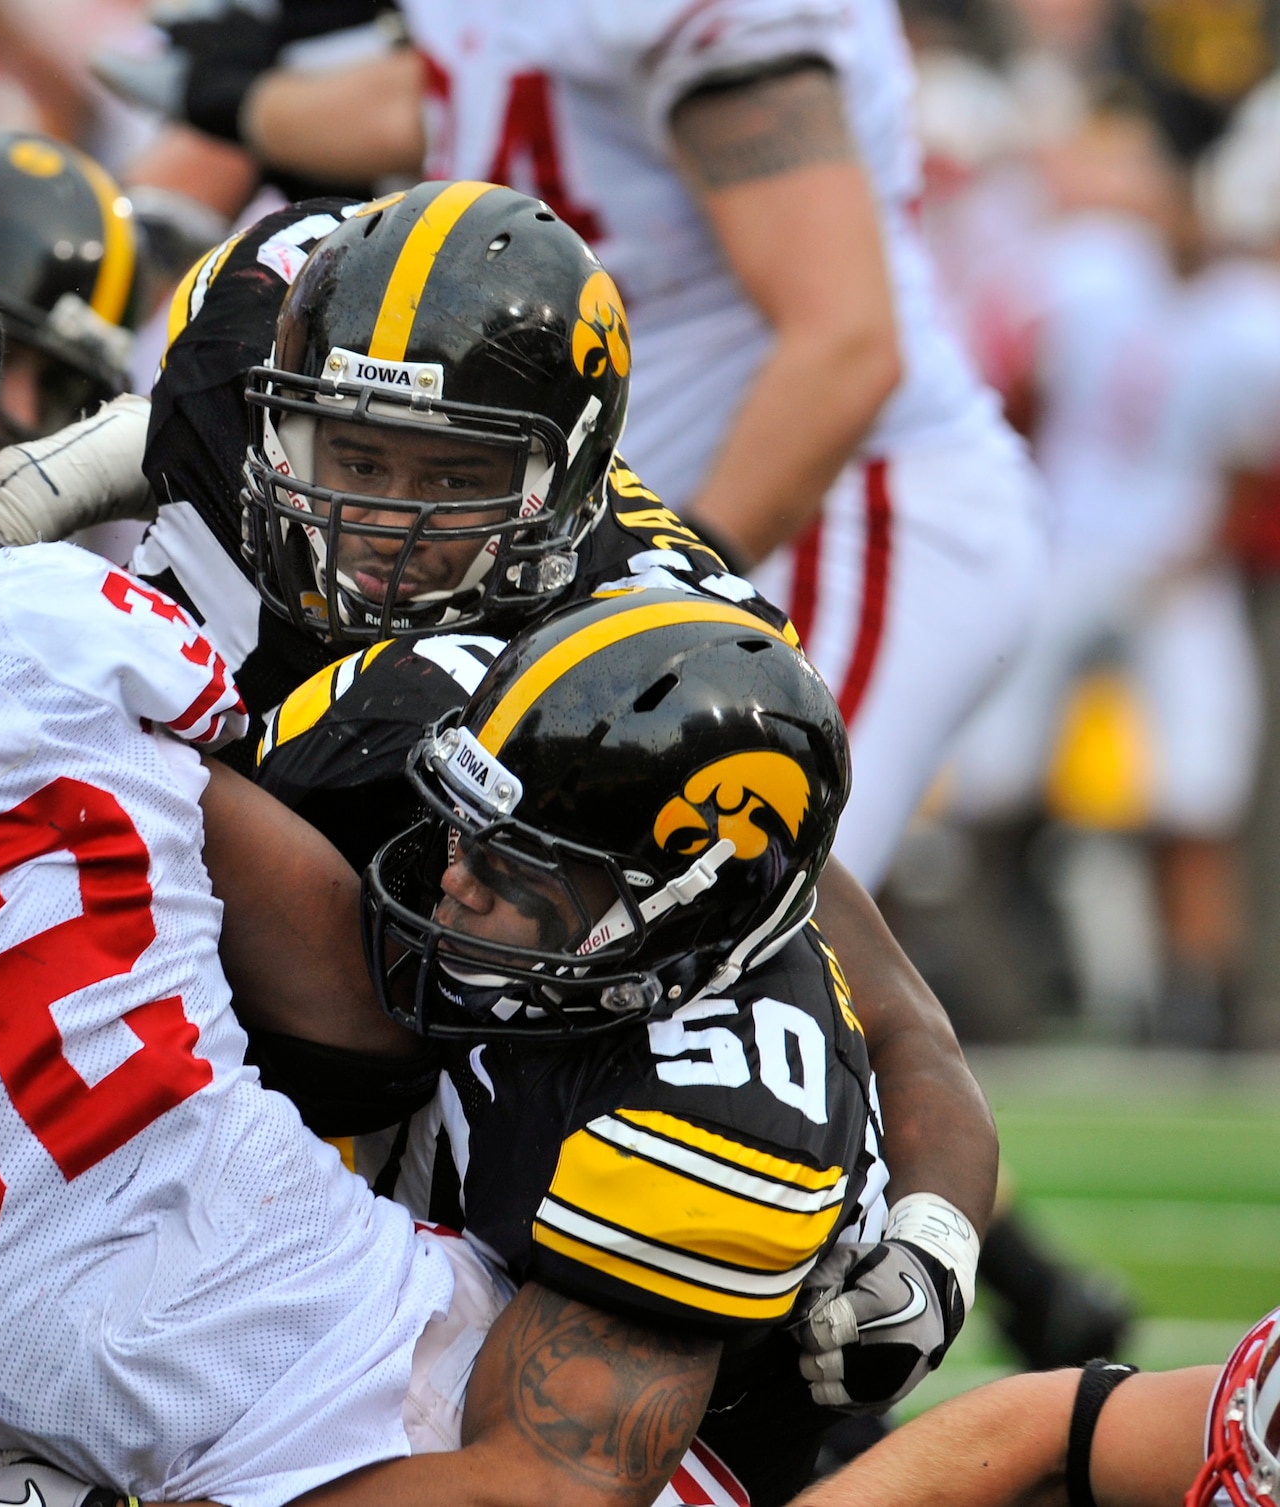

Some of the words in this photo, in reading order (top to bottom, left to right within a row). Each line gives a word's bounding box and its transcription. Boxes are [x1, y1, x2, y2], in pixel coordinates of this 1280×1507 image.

[356, 363, 412, 386] IOWA
[456, 743, 489, 787] IOWA
[623, 872, 654, 885] PEED
[646, 996, 829, 1125] 50
